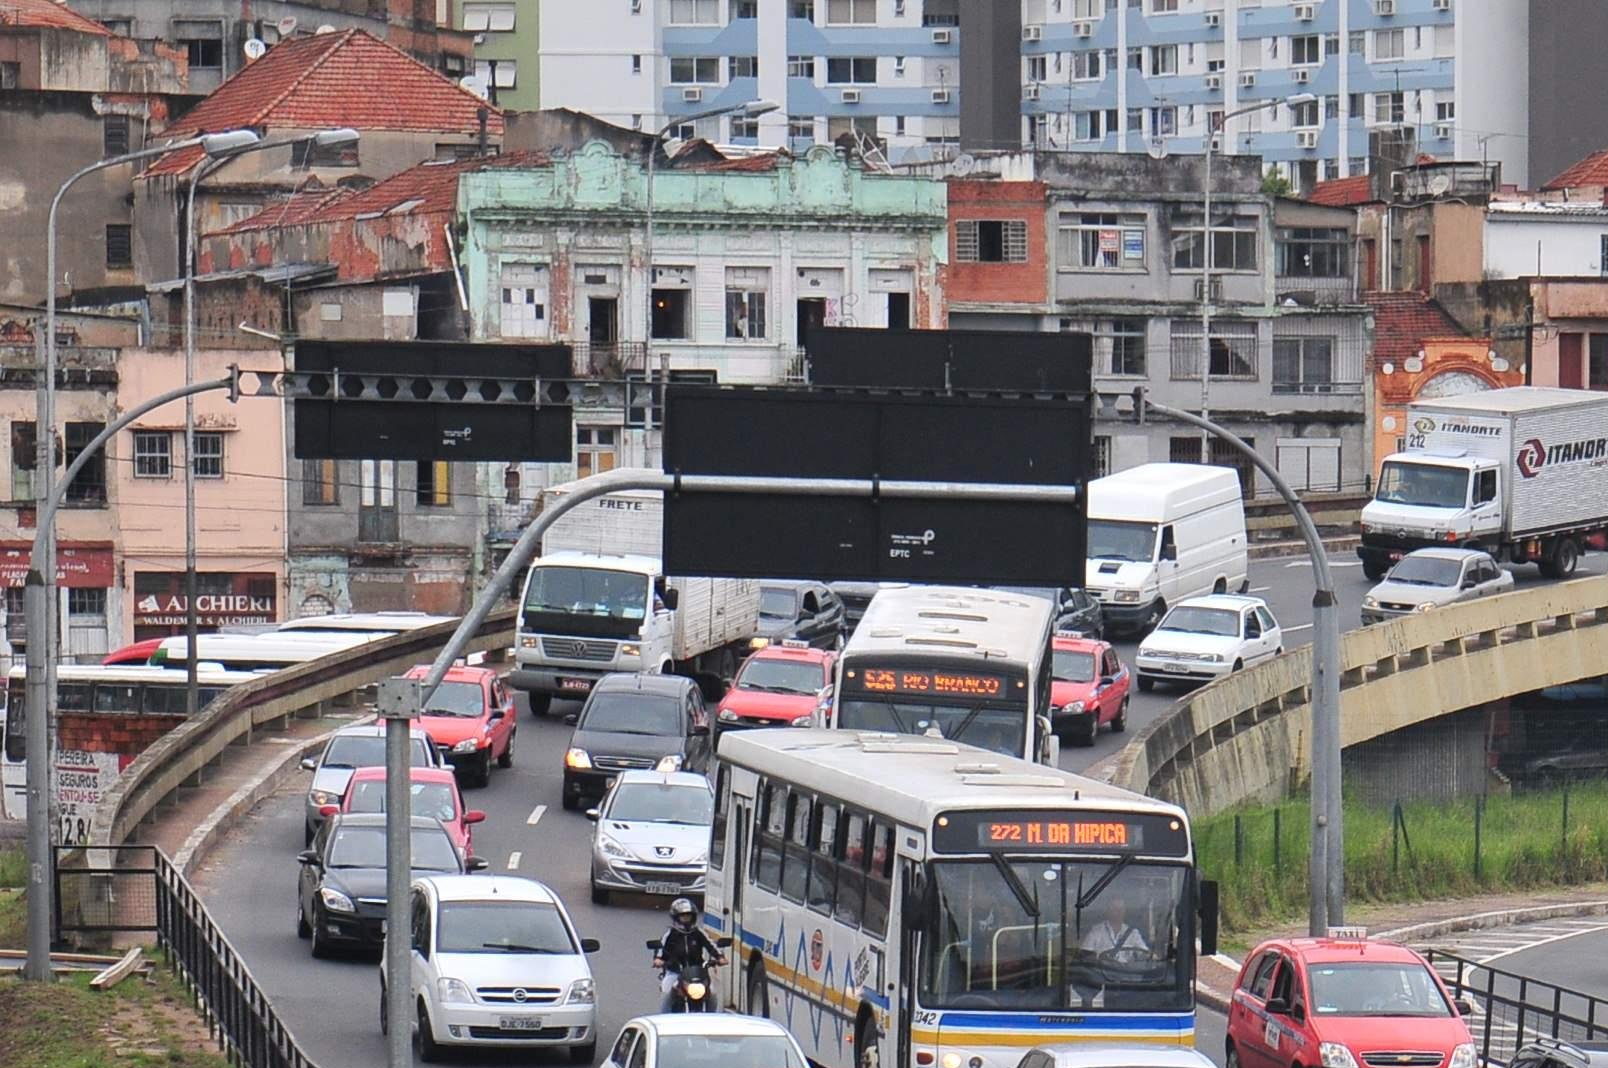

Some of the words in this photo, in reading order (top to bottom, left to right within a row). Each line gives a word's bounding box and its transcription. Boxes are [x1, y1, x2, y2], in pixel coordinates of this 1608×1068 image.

[1441, 423, 1502, 436] ITANORTE
[1409, 434, 1425, 449] 212
[600, 499, 643, 511] FRETE
[991, 824, 1022, 840] 272
[1048, 823, 1070, 843] DA
[1074, 823, 1126, 844] HIPICA
